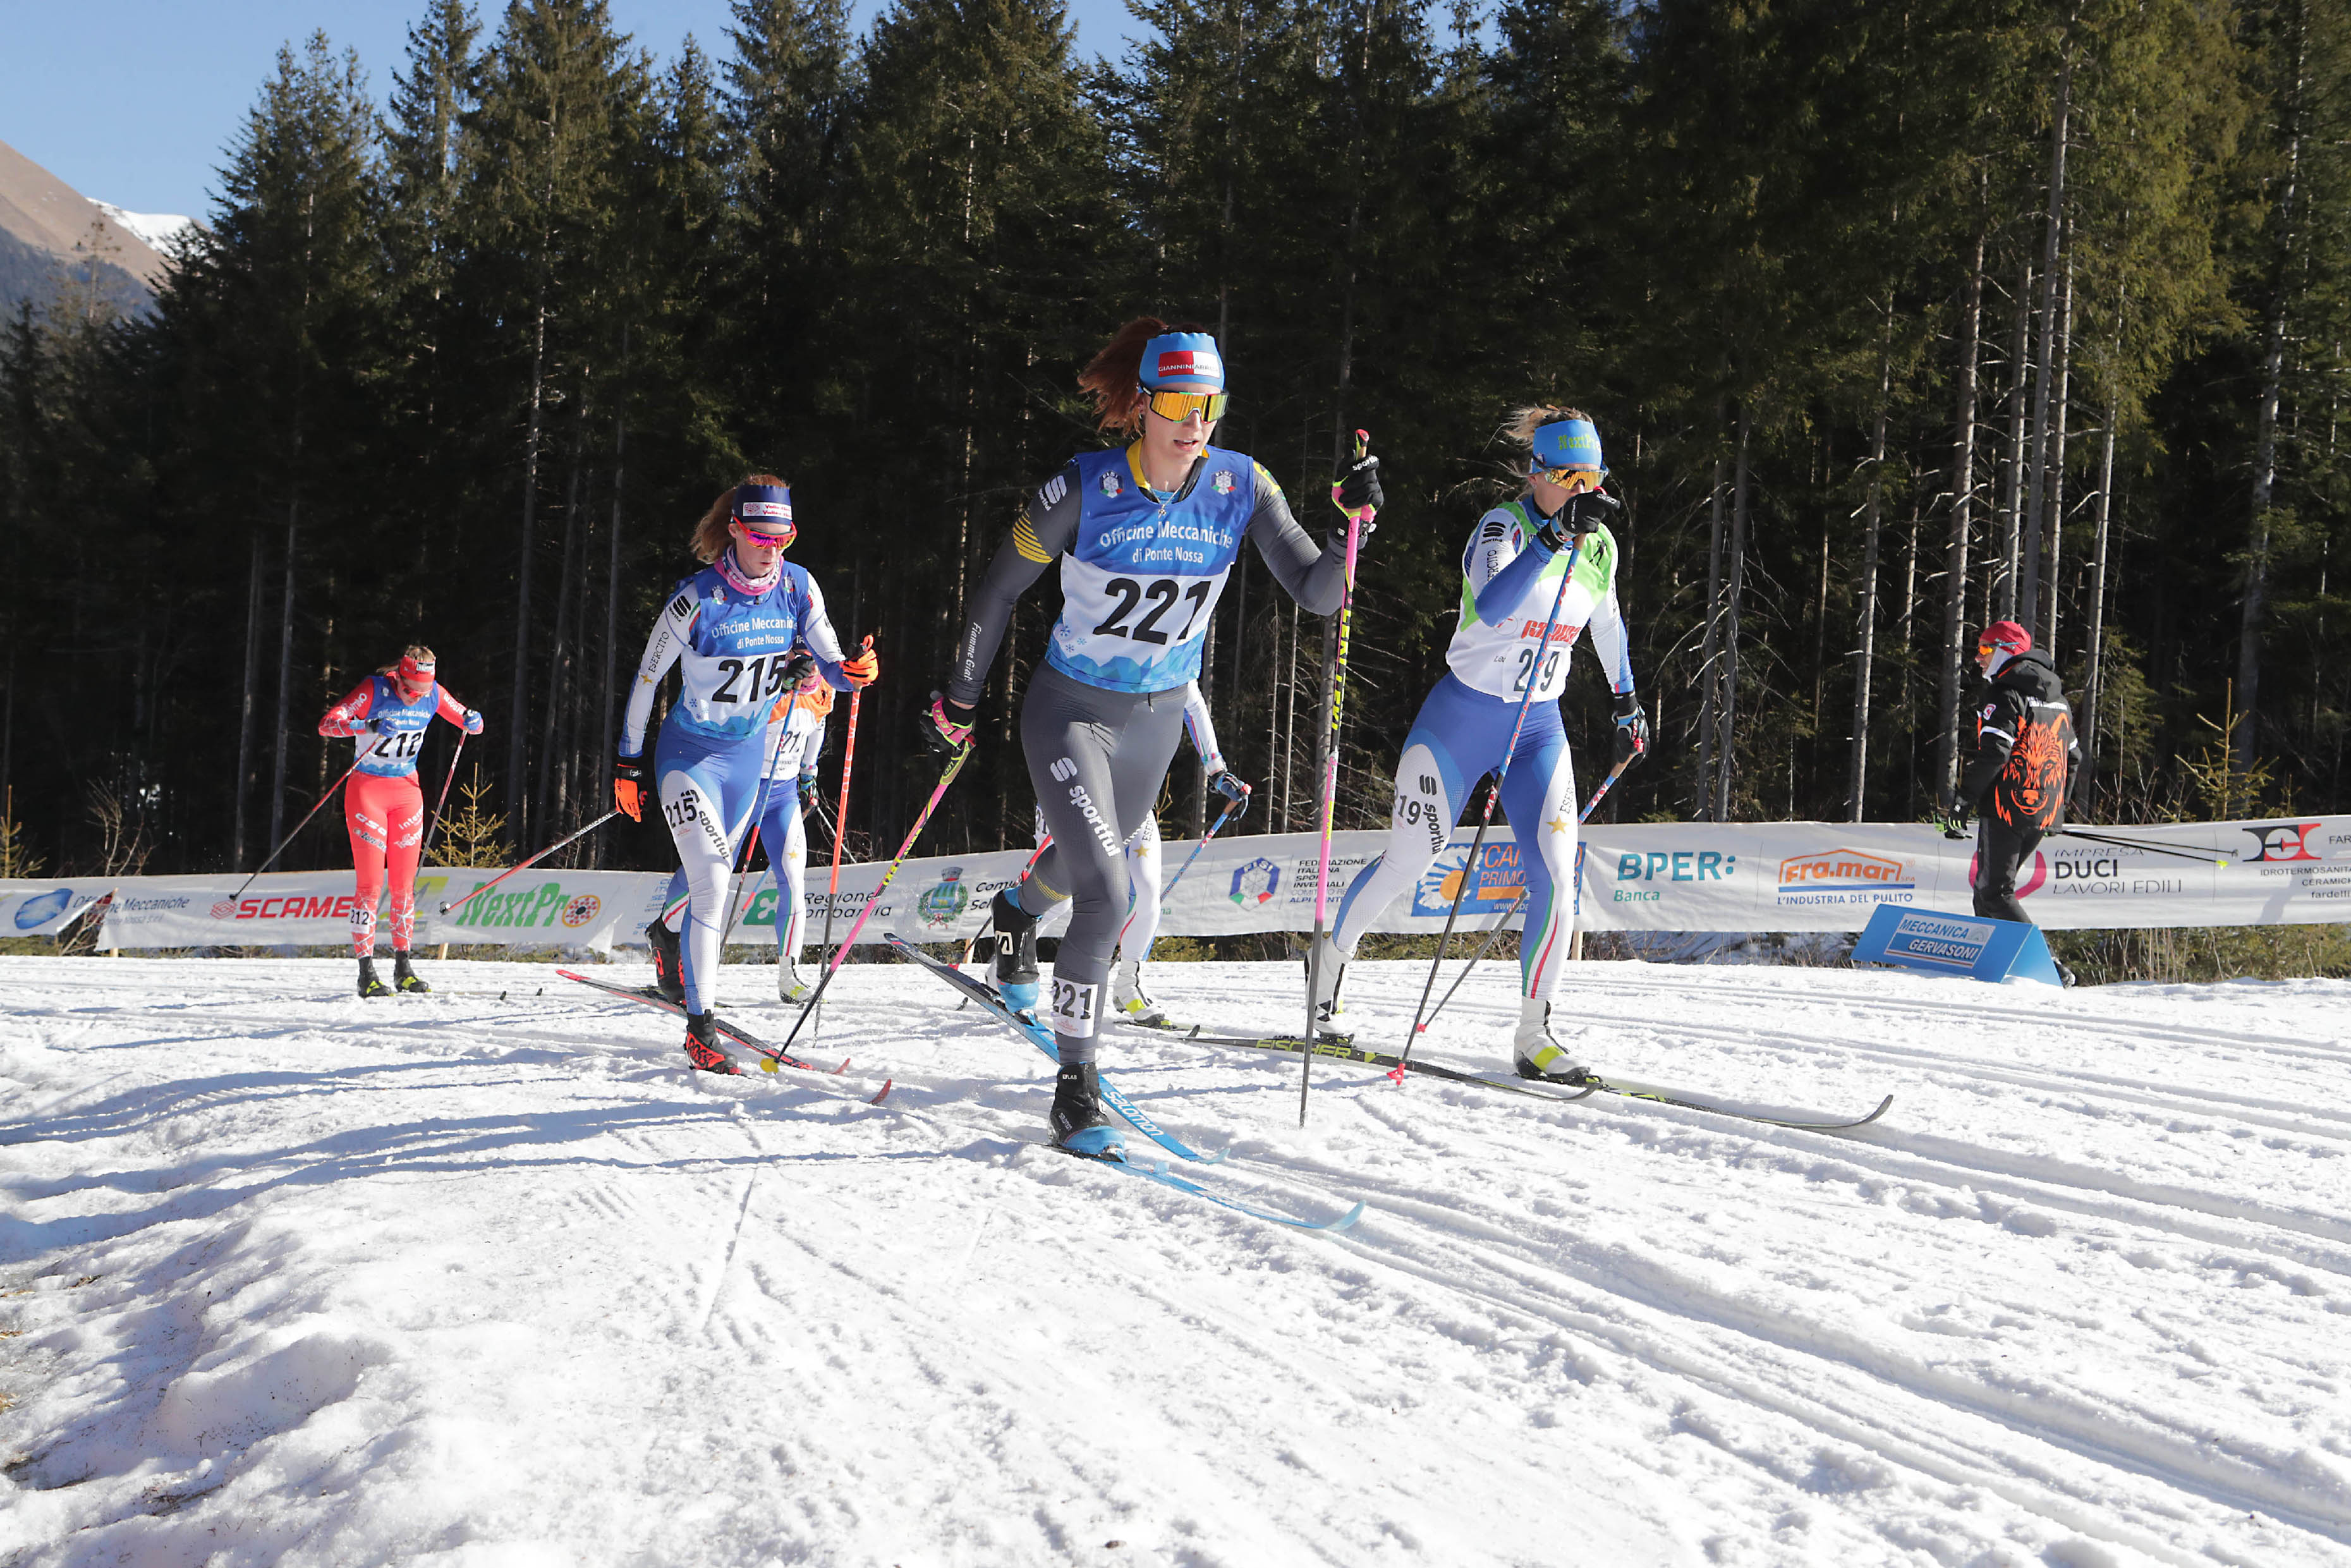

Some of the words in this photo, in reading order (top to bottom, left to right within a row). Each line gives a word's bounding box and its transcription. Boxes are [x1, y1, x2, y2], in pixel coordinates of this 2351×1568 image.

[1158, 363, 1194, 372] GIANNINI
[1100, 524, 1154, 548] Officine
[1157, 521, 1233, 549] Meccaniche
[1133, 548, 1143, 564] di
[1145, 547, 1173, 562] Ponte
[1175, 547, 1204, 564] Nossa
[1092, 576, 1213, 647] 221
[711, 621, 750, 639] Officine
[967, 621, 981, 659] Fiamme
[648, 631, 669, 673] ESERCITO
[737, 638, 744, 650] di
[745, 636, 765, 649] Ponte
[765, 634, 784, 645] Nossa
[712, 653, 787, 704] 215
[665, 797, 697, 829] 215
[1069, 784, 1122, 858] sportful
[698, 810, 730, 860] sportful
[2055, 846, 2144, 858] IMPRESA
[1243, 860, 1274, 873] FISI
[2055, 858, 2118, 880] DUCI
[1479, 870, 1527, 885] PRIMO
[2053, 880, 2125, 895] LAVORI
[2134, 878, 2182, 894] EDILI
[1613, 889, 1661, 903] Banca
[1777, 895, 1845, 905] L'INDUSTRIA
[1850, 894, 1869, 904] DEL
[1873, 892, 1913, 903] PULITO
[235, 896, 355, 920] SCAME
[350, 909, 370, 925] 212
[1899, 919, 1970, 939] MECCANICA
[1908, 939, 1979, 960] GERVASONI
[1052, 980, 1093, 1020] 221
